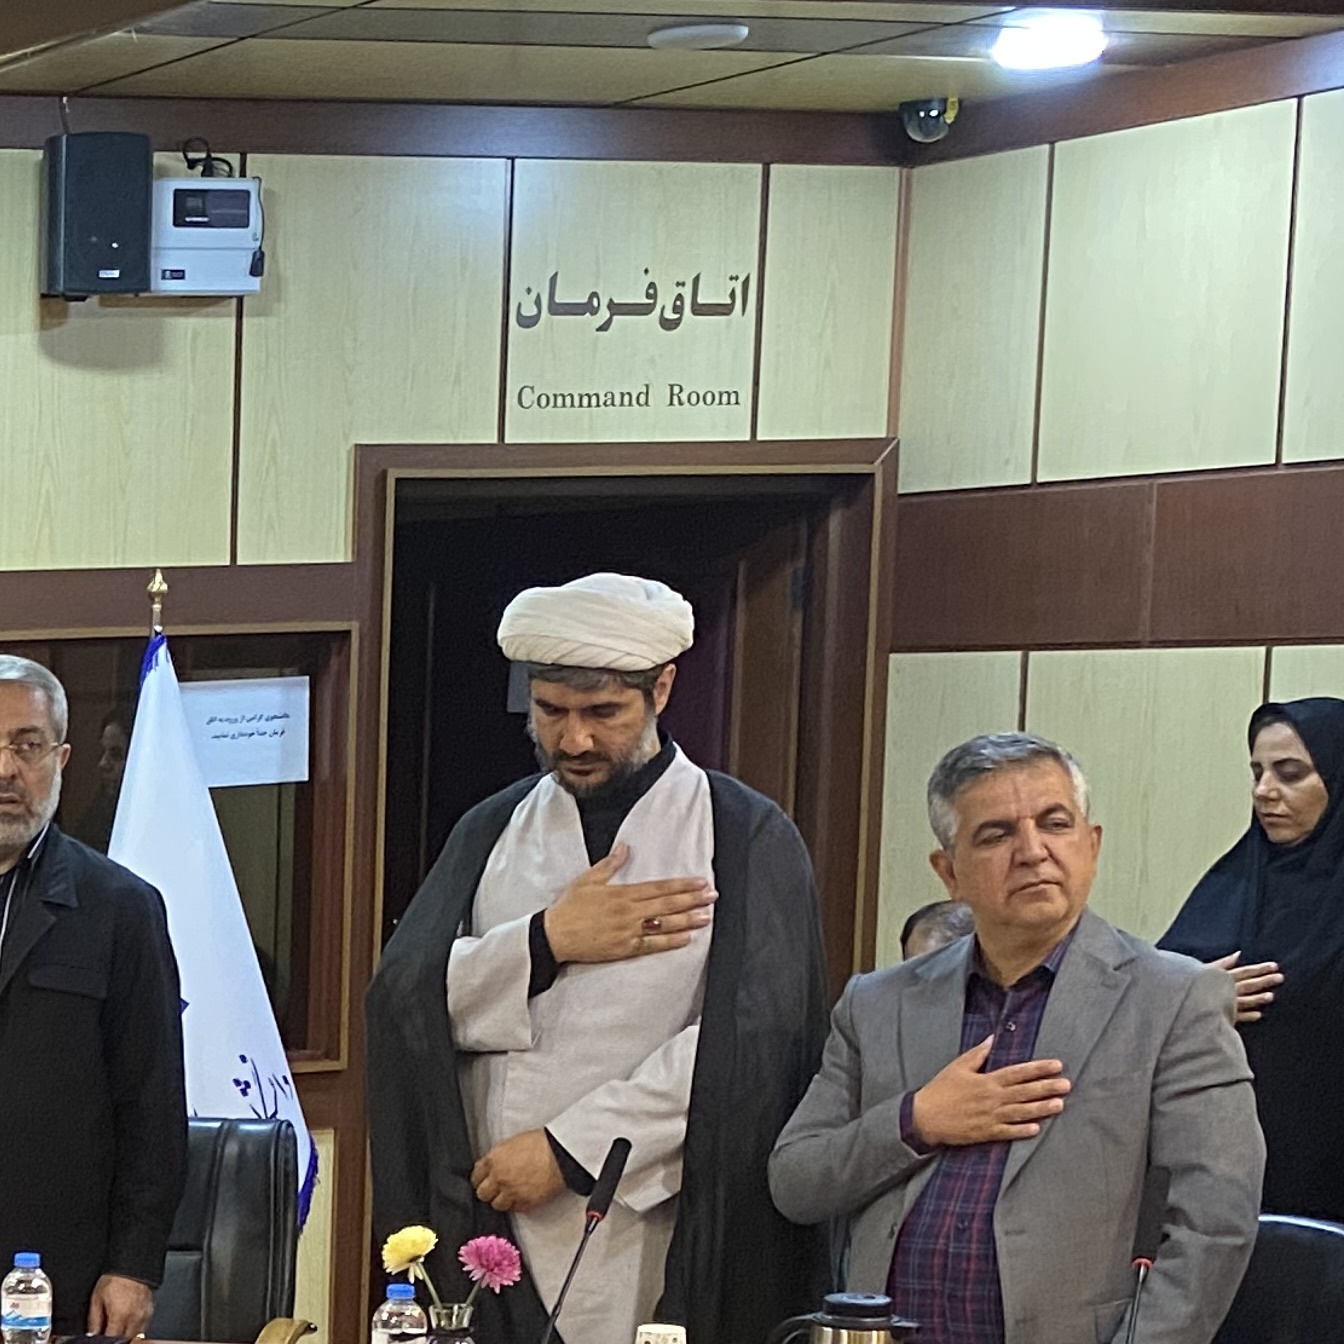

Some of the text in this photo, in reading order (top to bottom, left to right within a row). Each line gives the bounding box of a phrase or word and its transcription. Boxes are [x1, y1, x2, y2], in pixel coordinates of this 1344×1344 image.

[516, 267, 751, 332] اتاق فرمان
[517, 383, 741, 409] Command Room
